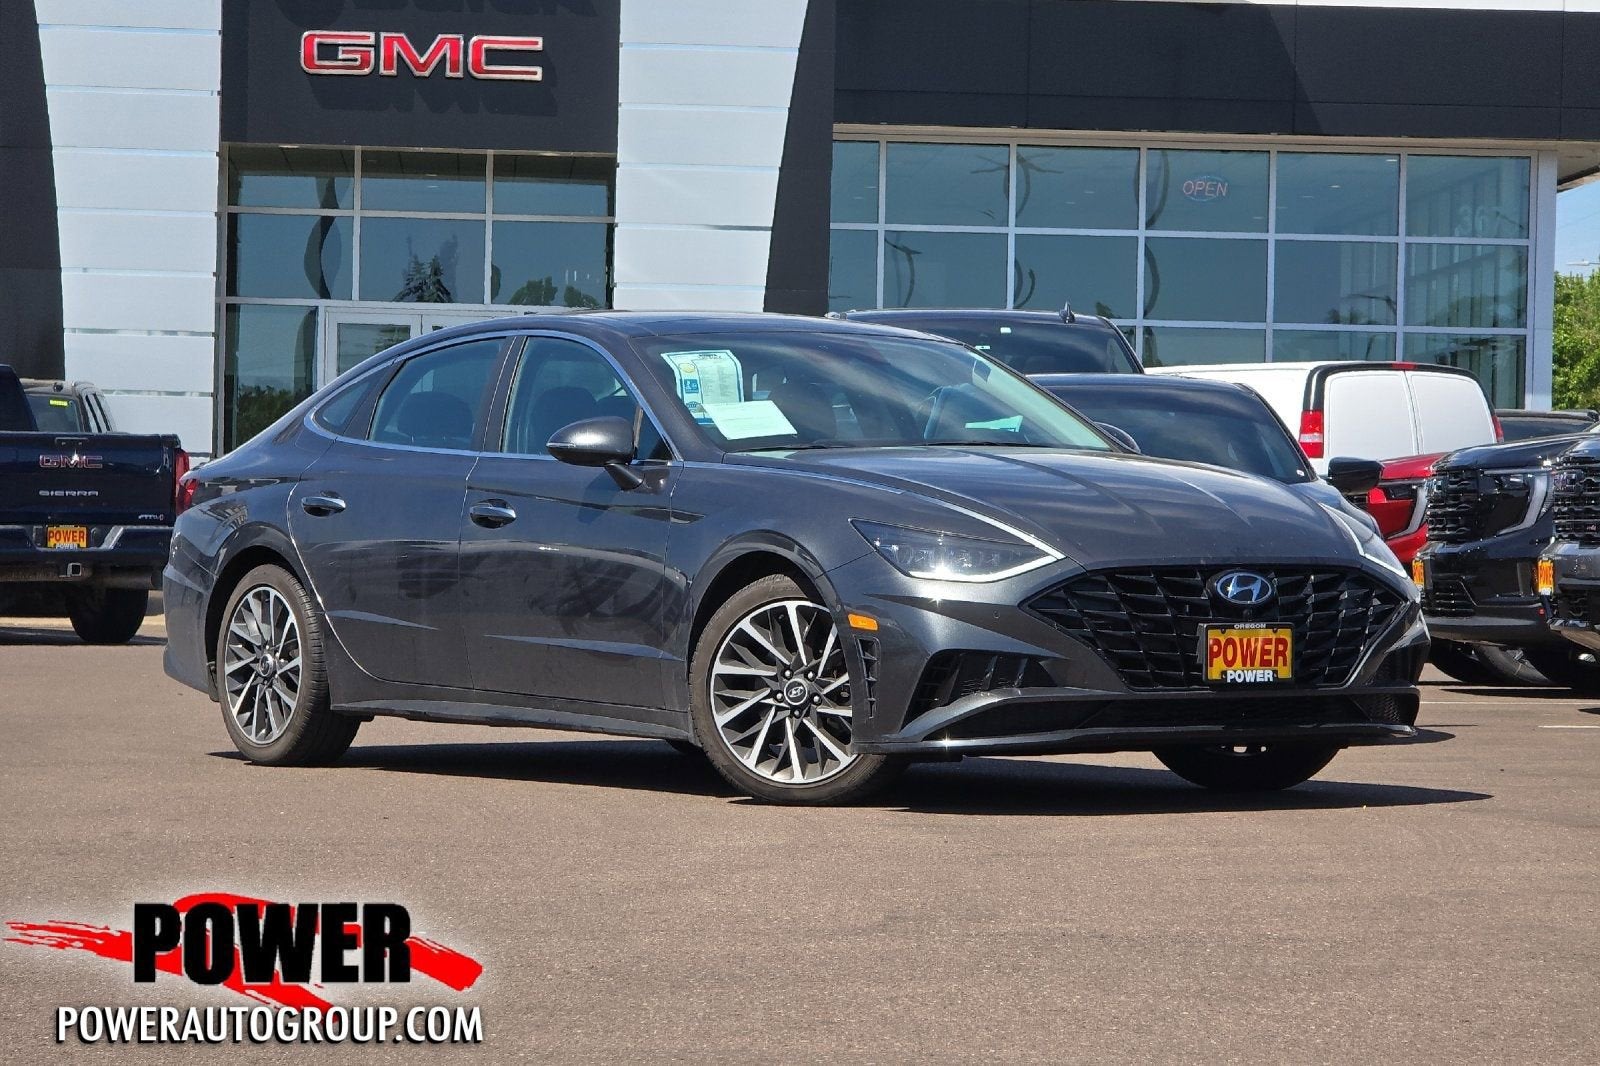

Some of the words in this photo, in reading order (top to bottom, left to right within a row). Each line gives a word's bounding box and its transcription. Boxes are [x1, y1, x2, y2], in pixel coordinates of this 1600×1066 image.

[300, 30, 544, 81] GMC
[1182, 180, 1228, 197] OPEN
[39, 454, 103, 469] GMC
[48, 530, 85, 543] POWER
[1209, 637, 1289, 668] POWER
[1226, 669, 1274, 683] POWER
